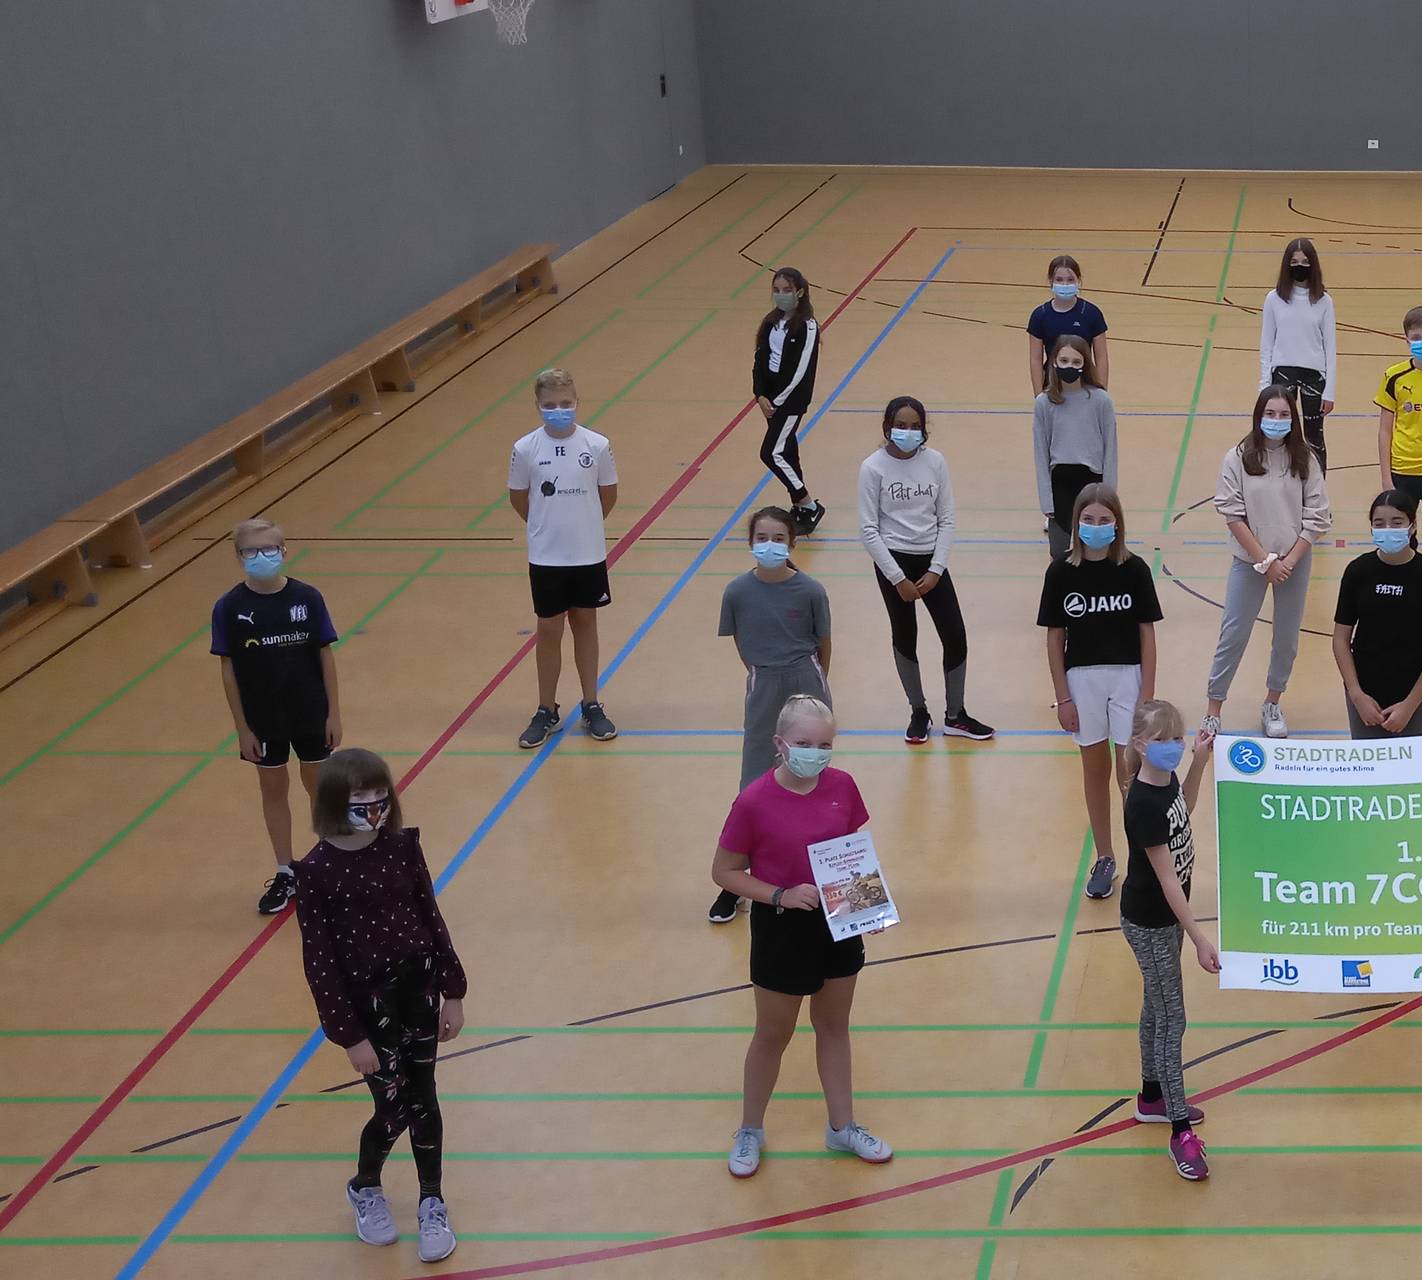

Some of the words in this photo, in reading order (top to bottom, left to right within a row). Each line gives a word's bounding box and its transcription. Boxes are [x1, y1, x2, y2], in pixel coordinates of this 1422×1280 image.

[555, 446, 566, 457] FE
[914, 484, 935, 497] chat
[1088, 593, 1132, 613] JAKO
[262, 630, 310, 646] sunmaker
[1273, 745, 1413, 762] STADTRADELN
[1316, 764, 1328, 772] ein
[1330, 765, 1351, 773] gutes
[1397, 841, 1422, 862] 1.
[1254, 871, 1356, 904] Team
[1261, 920, 1286, 935] für
[1289, 922, 1321, 936] 211
[1324, 922, 1350, 937] km
[1354, 924, 1382, 940] pro
[1262, 958, 1299, 980] ibb
